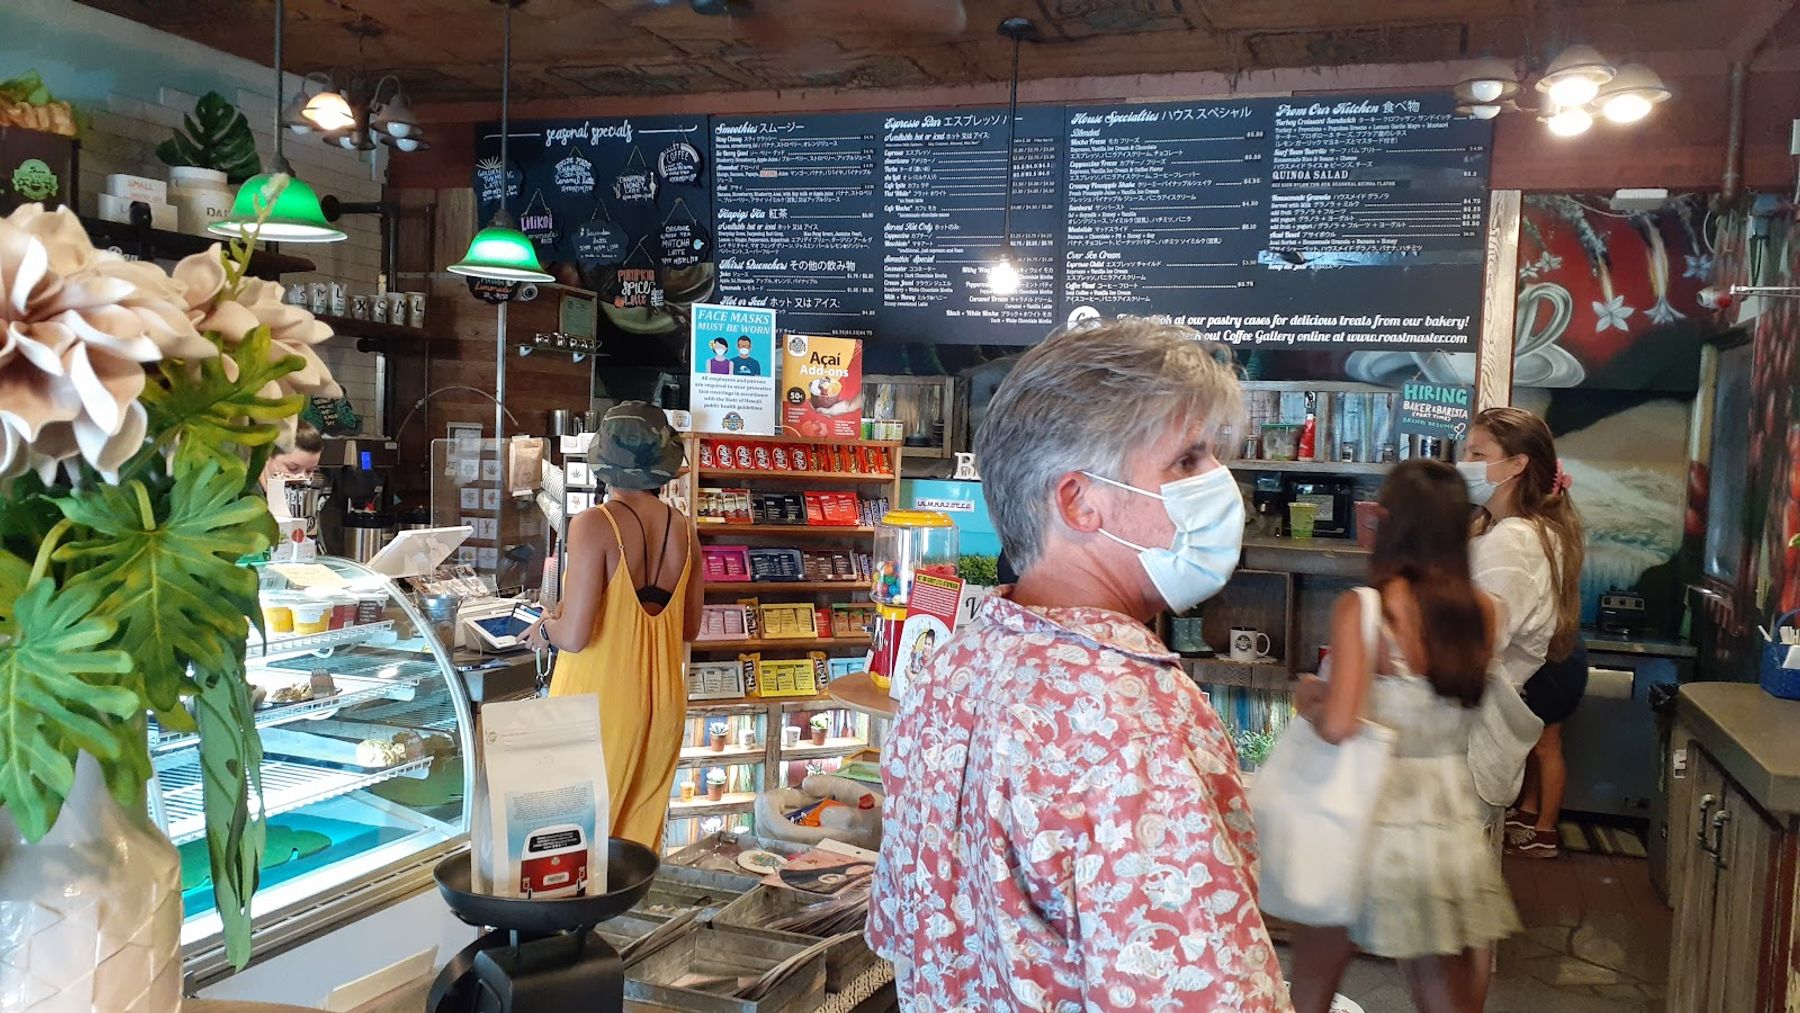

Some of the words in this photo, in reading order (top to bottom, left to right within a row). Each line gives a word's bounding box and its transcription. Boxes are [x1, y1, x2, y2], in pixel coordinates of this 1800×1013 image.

[1275, 104, 1306, 117] From
[1308, 102, 1330, 116] Our
[1332, 100, 1380, 115] Kitchen
[1382, 100, 1420, 114] 食べ物
[1071, 112, 1102, 125] House
[1104, 108, 1160, 127] Specialties
[1162, 110, 1194, 121] ハウス
[1196, 106, 1252, 120] スペシャル
[1276, 119, 1296, 128] Turkey
[1298, 118, 1326, 126] Croissant
[1326, 116, 1356, 124] Sandwich
[715, 121, 758, 134] Smoothies
[760, 122, 805, 133] スムージー
[884, 116, 920, 131] Espresso
[922, 116, 941, 127] Bar
[545, 120, 590, 148] seasonal
[590, 118, 634, 146] specials
[914, 132, 923, 140] hot
[1070, 128, 1100, 138] Blended
[1274, 148, 1288, 156] Surf
[1304, 148, 1327, 156] Burrito
[1070, 160, 1100, 168] Cappuccino
[1272, 170, 1310, 180] QUINOA
[1312, 170, 1349, 180] SALAD
[128, 180, 154, 191] SMALL
[1090, 182, 1118, 190] Pineapple
[1306, 194, 1331, 202] Granola
[718, 208, 748, 222] Teapigs
[750, 208, 766, 220] Tea
[768, 208, 788, 220] 紅茶
[904, 224, 917, 232] Hot
[918, 222, 934, 234] Only
[661, 239, 690, 248] MATCHA
[1066, 251, 1082, 260] Over
[1084, 250, 1097, 259] Ice
[1098, 250, 1121, 260] Cream
[718, 256, 744, 270] Thirst
[746, 258, 788, 272] Quenchers
[790, 260, 856, 272] その他の飲み物
[618, 269, 655, 282] PUMPKIN
[317, 288, 328, 298] M
[336, 288, 343, 299] L
[378, 301, 387, 315] S
[415, 301, 424, 312] L
[720, 296, 736, 306] Hot
[737, 296, 746, 306] or
[748, 296, 768, 306] Iced
[771, 298, 792, 308] ホット
[794, 298, 812, 308] 又は
[698, 310, 728, 321] FACE
[730, 312, 770, 325] MASKS
[1174, 314, 1185, 326] at
[1187, 316, 1206, 326] our
[1206, 314, 1242, 328] pastry
[1244, 316, 1270, 326] cases
[1272, 314, 1288, 328] for
[1290, 314, 1338, 326] delicious
[1339, 314, 1372, 326] treats
[1372, 314, 1400, 328] from
[1402, 317, 1424, 326] our
[1424, 316, 1470, 330] bakery!
[697, 322, 726, 332] MUST
[726, 324, 739, 332] BE
[740, 325, 770, 335] WORN
[1204, 330, 1221, 342] out
[1222, 330, 1253, 344] Coffee
[1254, 330, 1294, 346] Gallery
[1296, 331, 1330, 342] online
[1332, 332, 1346, 342] at
[1346, 332, 1468, 344] www.roastmaster.com
[810, 352, 840, 368] Açaí
[800, 364, 848, 377] Add-ons
[1404, 384, 1468, 406] HIRING
[1403, 400, 1432, 414] BAKER
[1436, 406, 1468, 420] BARISTA
